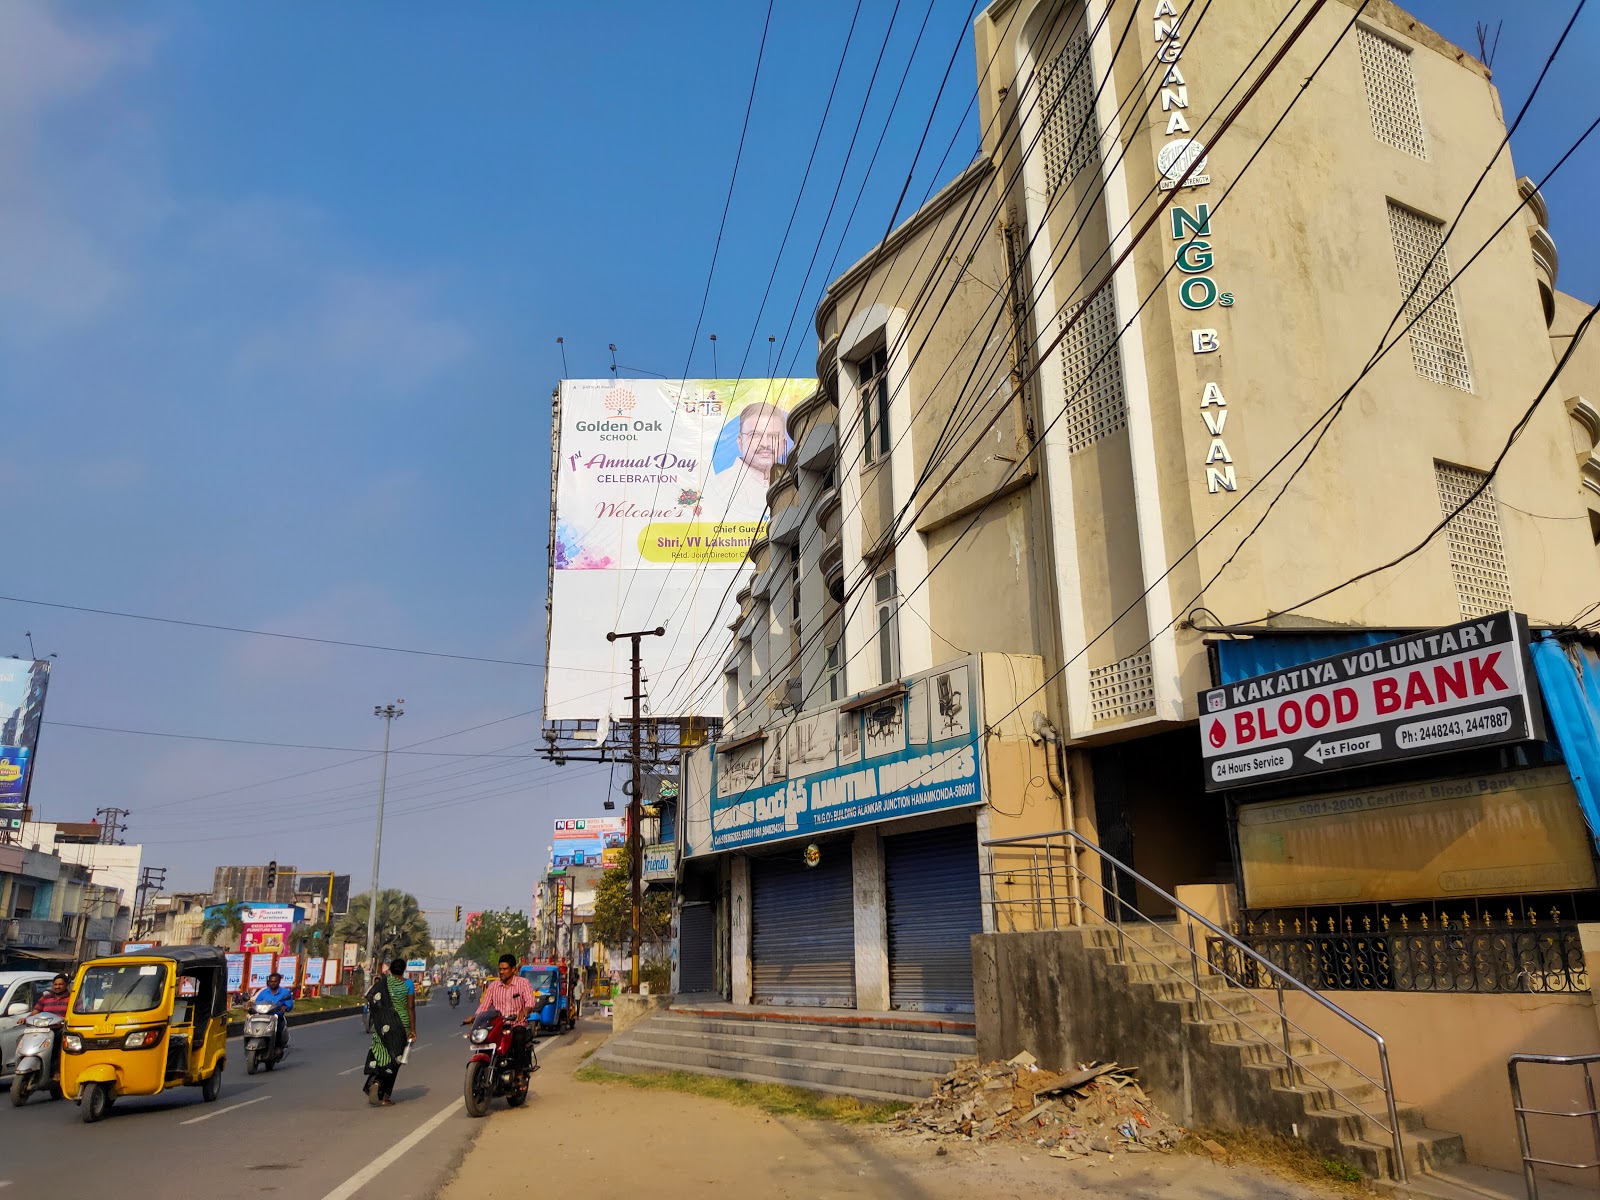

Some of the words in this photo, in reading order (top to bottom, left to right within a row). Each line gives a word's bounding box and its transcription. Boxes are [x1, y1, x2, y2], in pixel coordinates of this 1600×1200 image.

[575, 420, 628, 432] Golden
[633, 420, 663, 432] Oak
[568, 450, 583, 472] 1st
[584, 452, 651, 470] Annual
[653, 452, 699, 473] Day
[596, 474, 678, 484] CELEBRATION
[595, 501, 686, 519] Welcome's
[713, 525, 736, 534] Chief
[657, 536, 683, 548] Shri.
[686, 536, 701, 547] VV
[671, 551, 689, 559] Retd.
[710, 551, 738, 559] Director
[1233, 663, 1338, 705] KAKATIYA
[1340, 619, 1496, 677] VOLUNTARY
[1234, 687, 1360, 745] BLOOD
[1373, 650, 1510, 716] BANK
[1419, 722, 1465, 743] 2448243,
[1465, 711, 1509, 734] 2447887
[1316, 744, 1336, 758] 1st
[1339, 738, 1371, 754] Floor
[1217, 764, 1227, 777] 24
[1228, 758, 1252, 775] Hours
[1253, 754, 1285, 771] Service
[1366, 787, 1427, 808] Certified
[1429, 780, 1473, 800] Blood
[1477, 775, 1516, 795] Bank
[833, 804, 857, 822] BUILDING
[857, 800, 883, 817] ALANKAR
[882, 796, 912, 812] JUNCTION
